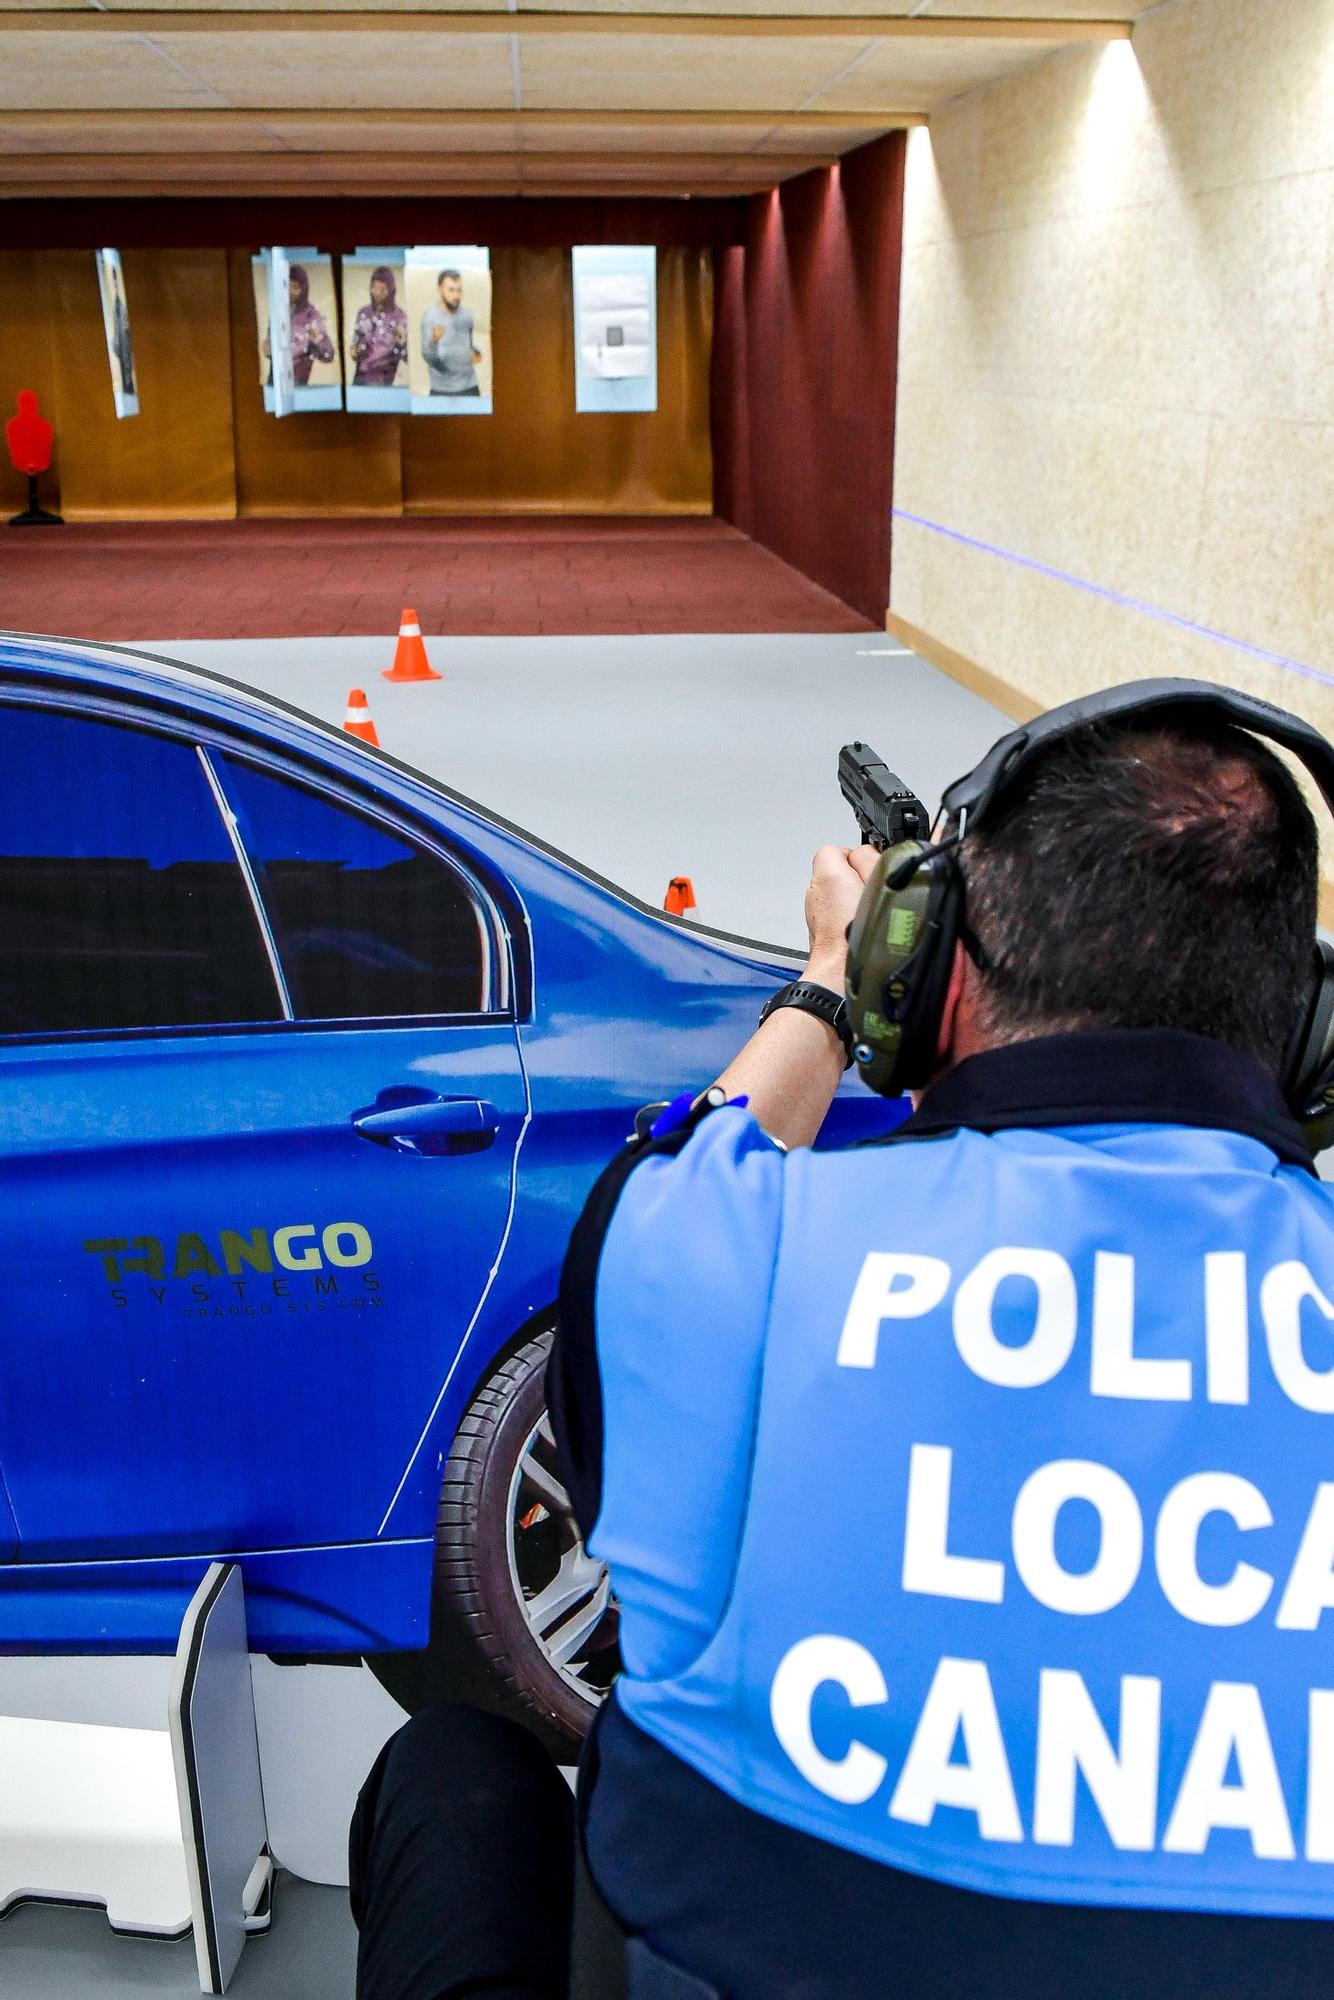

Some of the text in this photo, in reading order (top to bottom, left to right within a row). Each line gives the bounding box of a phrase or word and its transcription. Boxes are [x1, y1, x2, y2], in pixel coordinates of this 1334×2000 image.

[83, 1222, 373, 1283] TRANGO
[111, 1272, 381, 1308] SYSTEMS
[184, 1298, 383, 1319] TRANGO-SYSCOM
[770, 1634, 1334, 1864] CANA
